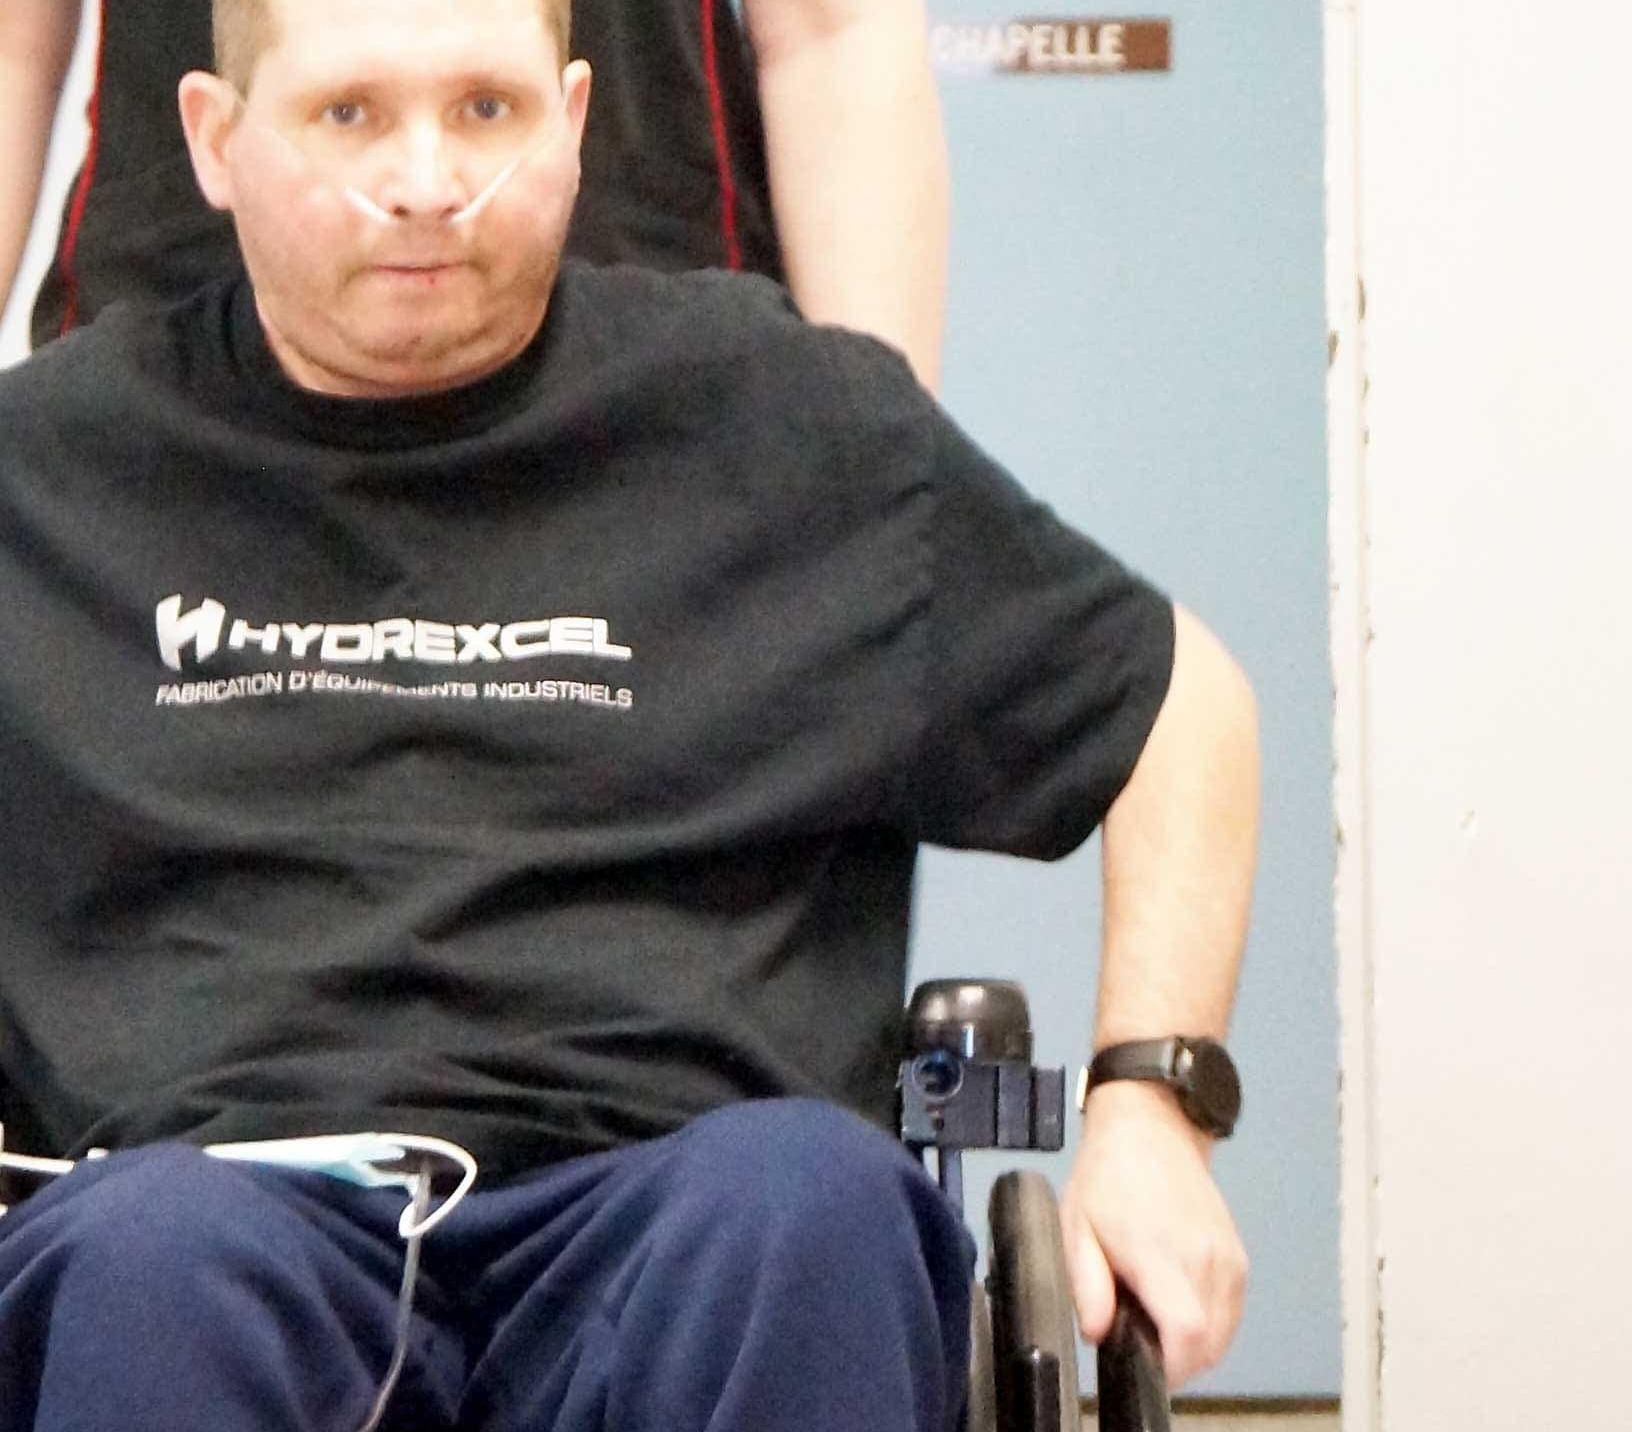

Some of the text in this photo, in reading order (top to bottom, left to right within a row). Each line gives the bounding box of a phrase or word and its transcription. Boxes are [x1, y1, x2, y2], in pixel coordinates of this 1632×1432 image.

[228, 616, 633, 664] HYDREXCEL
[155, 671, 282, 706] FABRICATION
[484, 680, 634, 708] INDUSTRIELS
